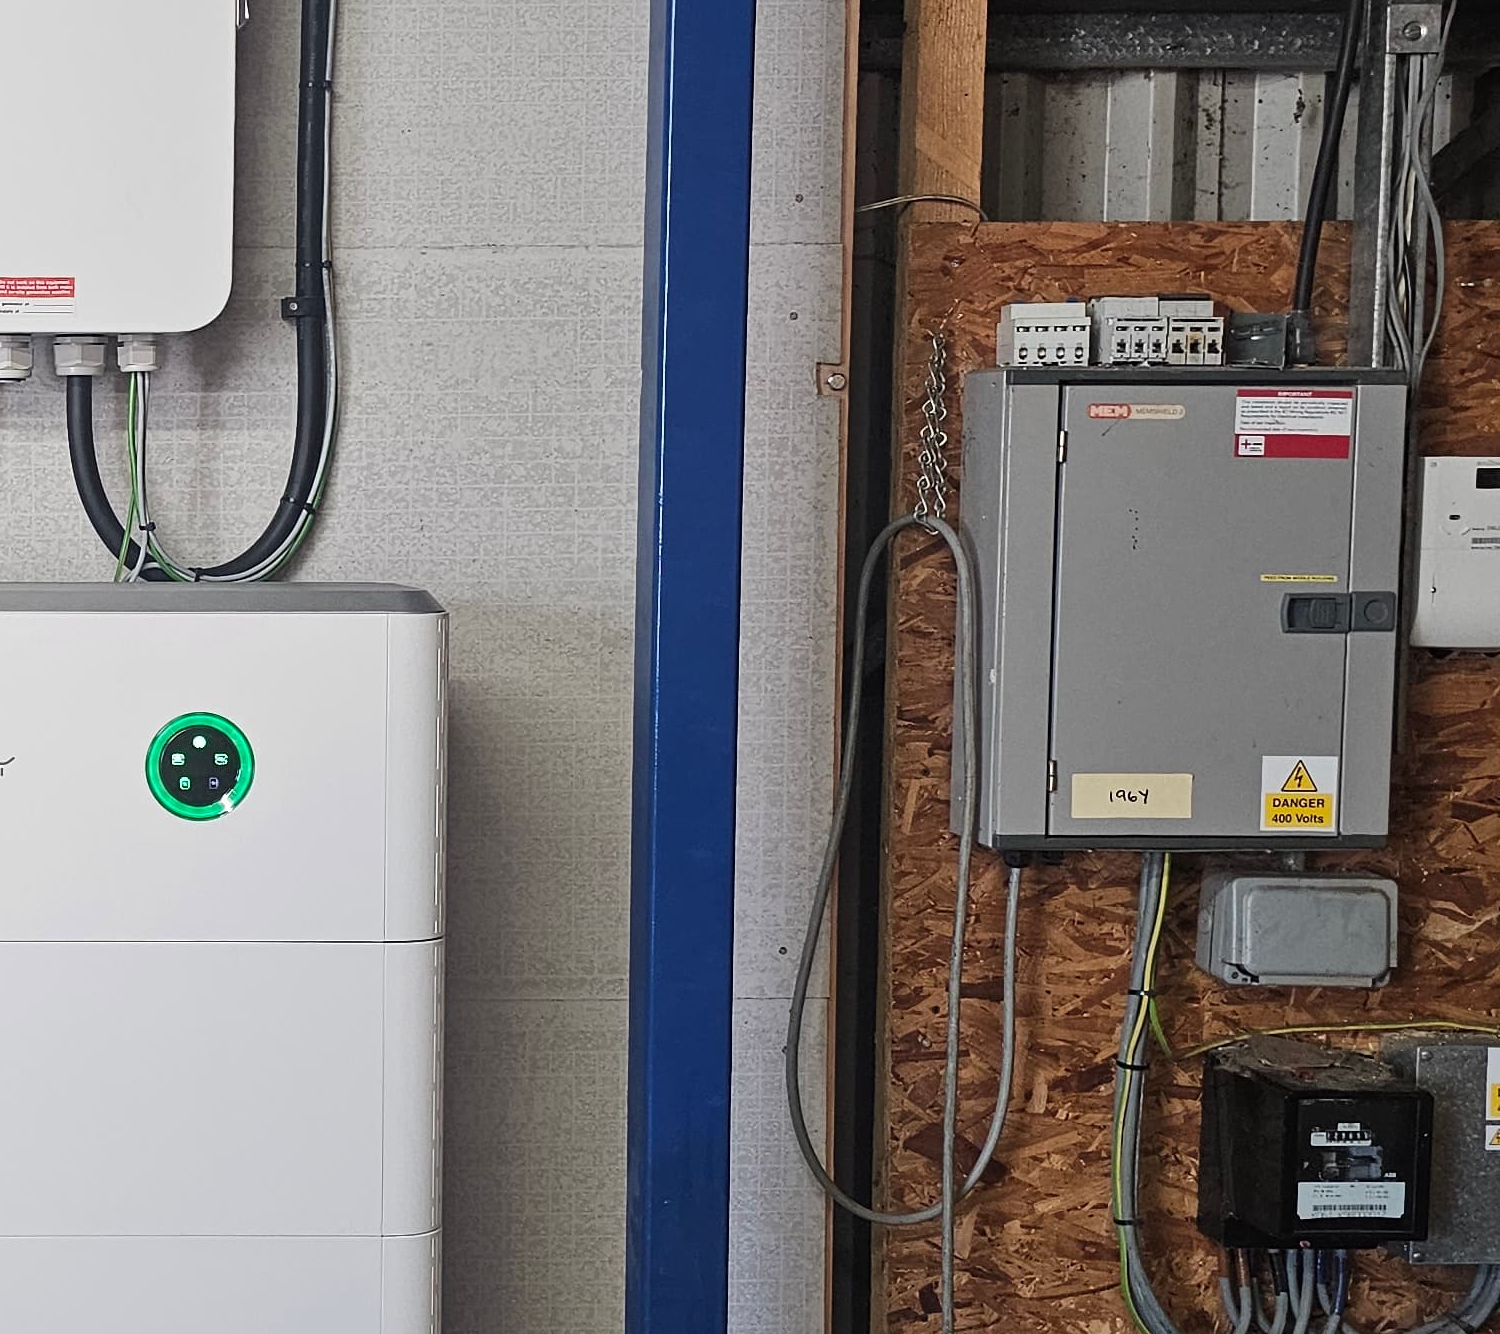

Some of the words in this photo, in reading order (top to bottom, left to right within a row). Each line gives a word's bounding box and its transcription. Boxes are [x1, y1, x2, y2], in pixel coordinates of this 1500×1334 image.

[1089, 404, 1129, 419] MEM
[1272, 797, 1325, 809] DANGER
[1271, 813, 1292, 824] 400
[1295, 812, 1325, 825] Volts
